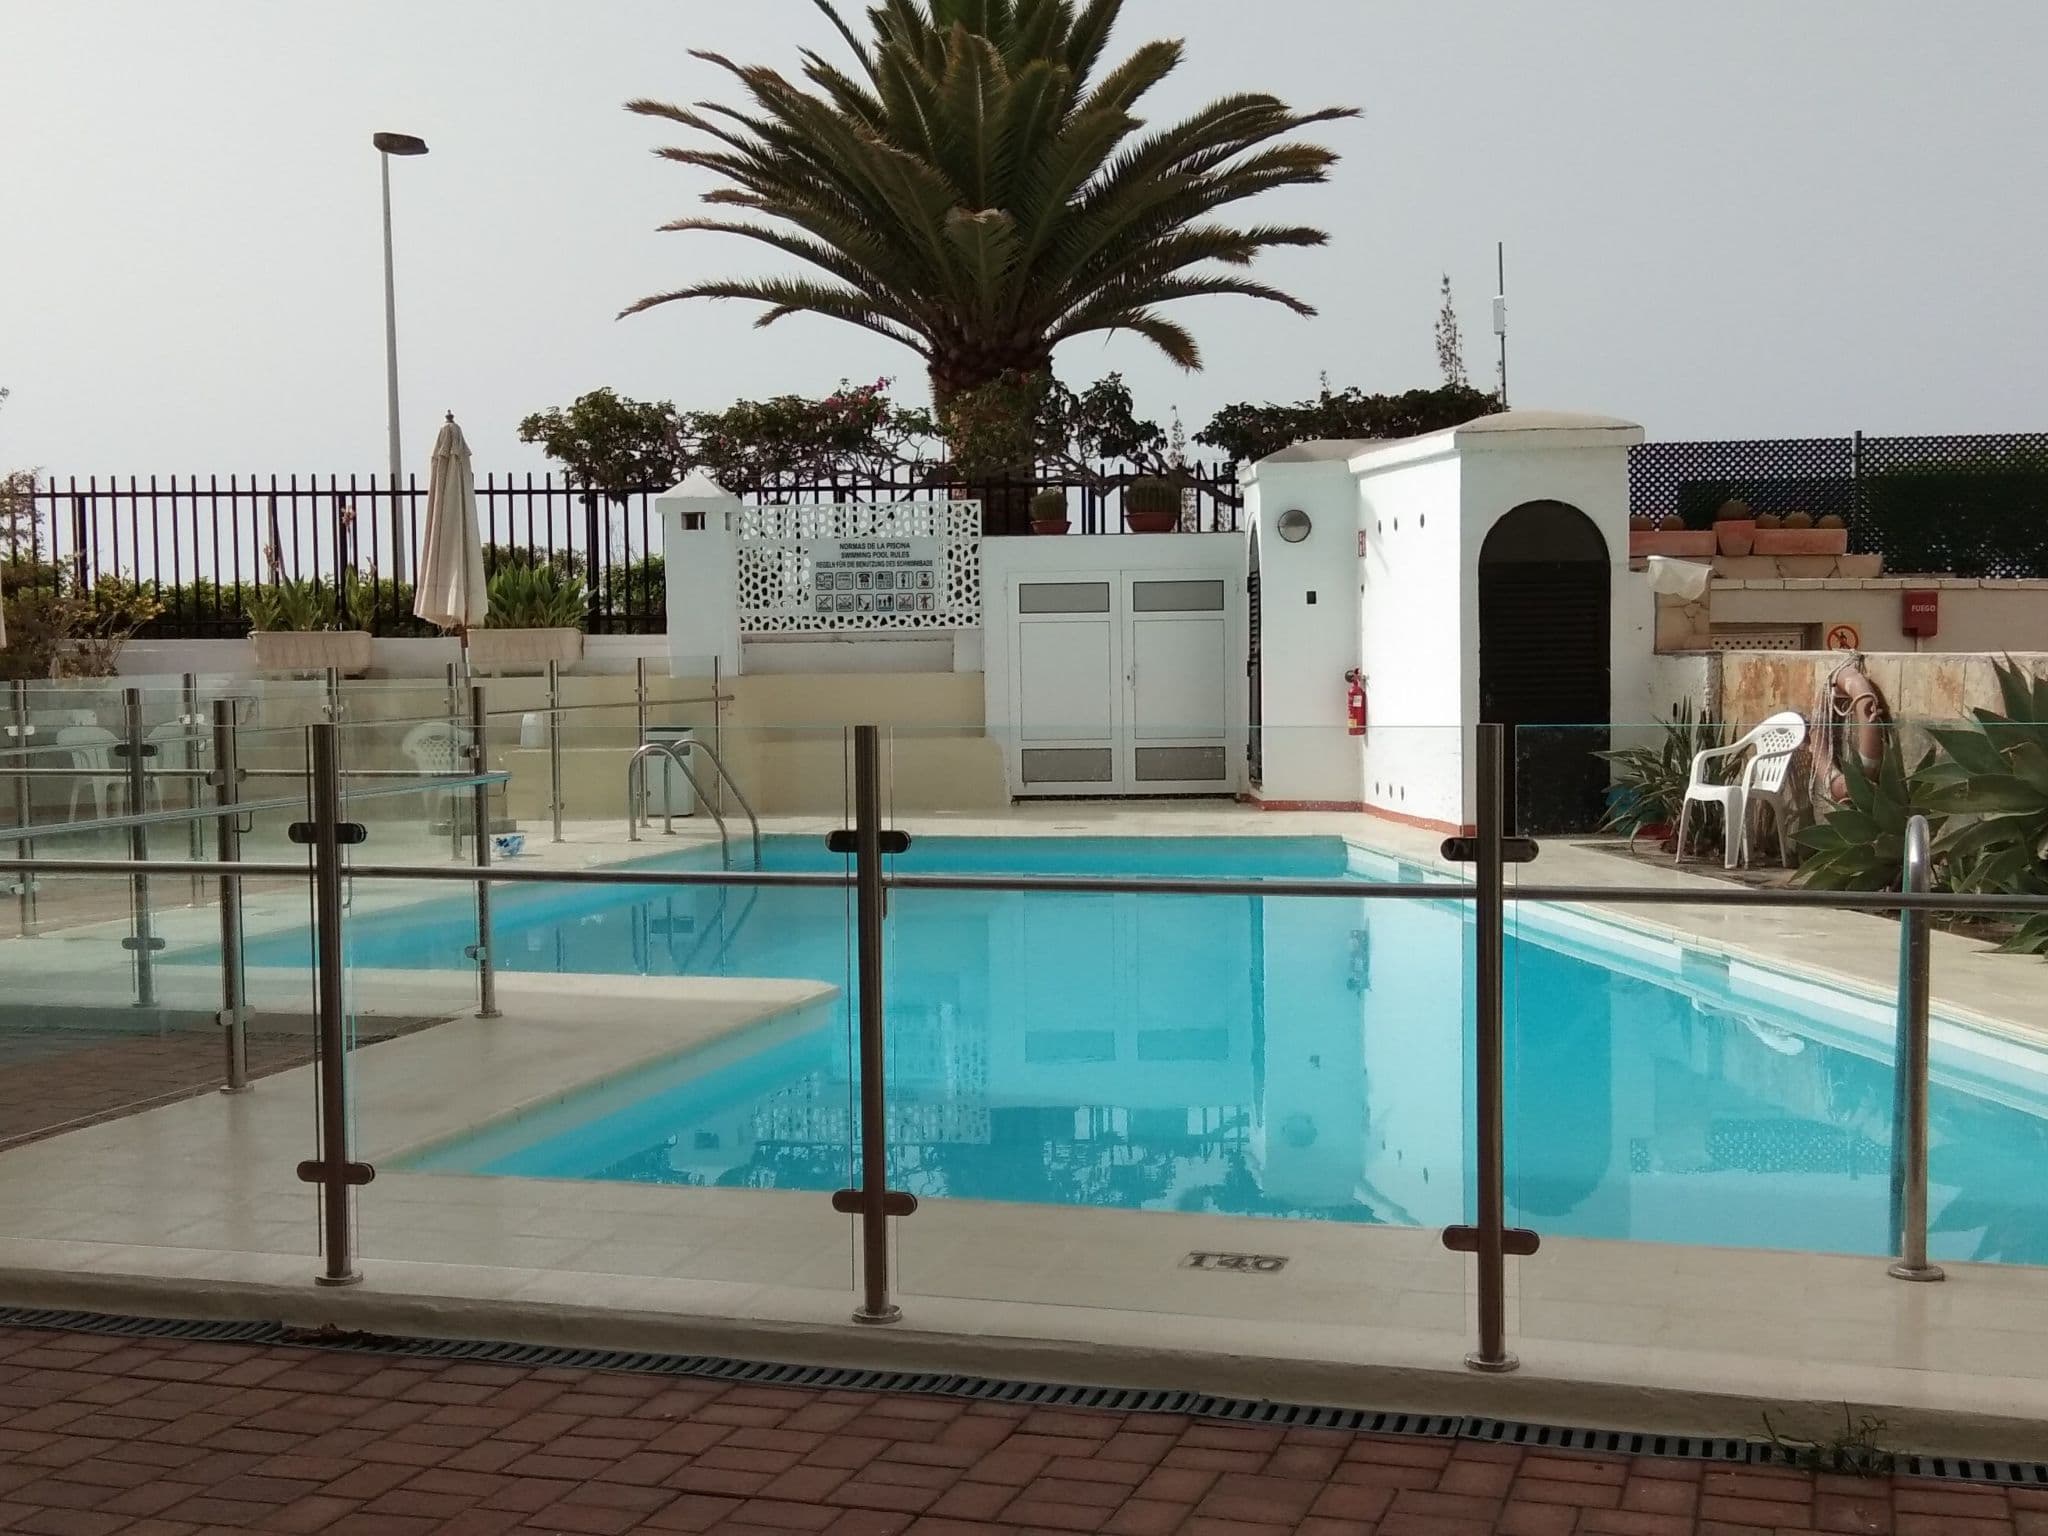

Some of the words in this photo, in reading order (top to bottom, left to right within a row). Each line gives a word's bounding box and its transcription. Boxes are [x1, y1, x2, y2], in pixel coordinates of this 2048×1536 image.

[839, 542, 866, 550] NORMAS
[867, 542, 876, 550] DE
[876, 542, 885, 550] LA
[1911, 604, 1936, 612] FUEGO
